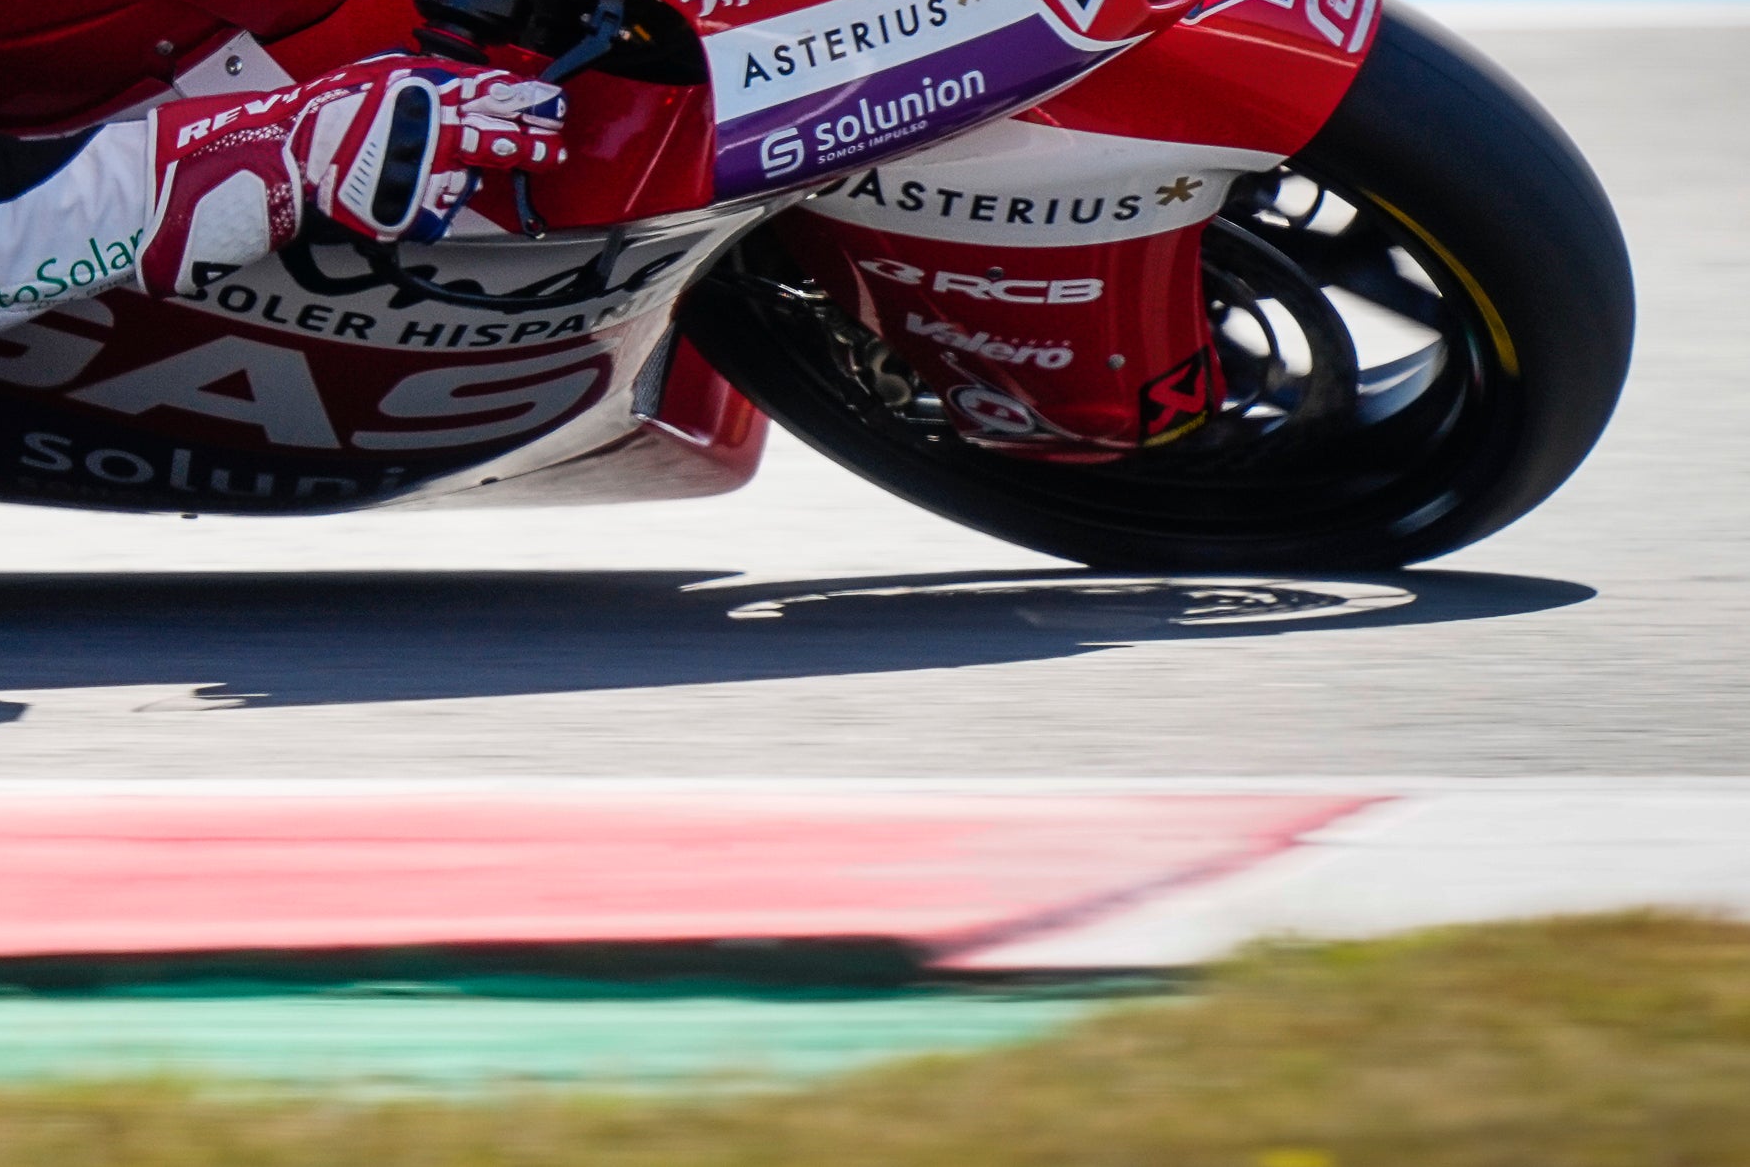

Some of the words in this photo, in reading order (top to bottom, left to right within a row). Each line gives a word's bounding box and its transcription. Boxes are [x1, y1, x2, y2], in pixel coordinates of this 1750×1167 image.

[815, 69, 986, 152] solunion
[817, 142, 865, 165] SOMOS
[868, 119, 929, 148] IMPULSO
[848, 167, 1140, 225] ASTERIUS
[932, 271, 1104, 304] RCB
[396, 297, 650, 348] HISPAN
